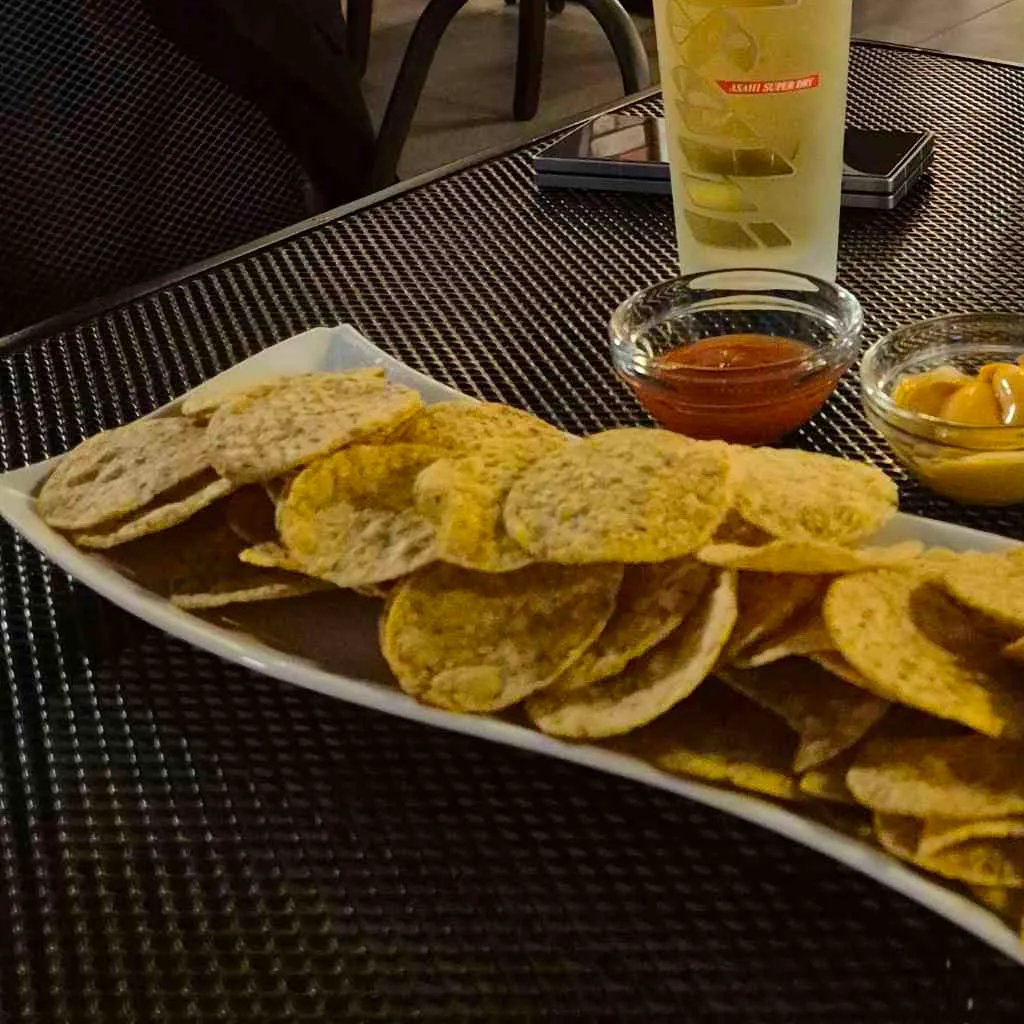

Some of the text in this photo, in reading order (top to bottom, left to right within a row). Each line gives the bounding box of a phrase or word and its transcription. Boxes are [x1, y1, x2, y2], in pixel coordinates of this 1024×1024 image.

[729, 78, 814, 93] ASAHI SUPER DRY
